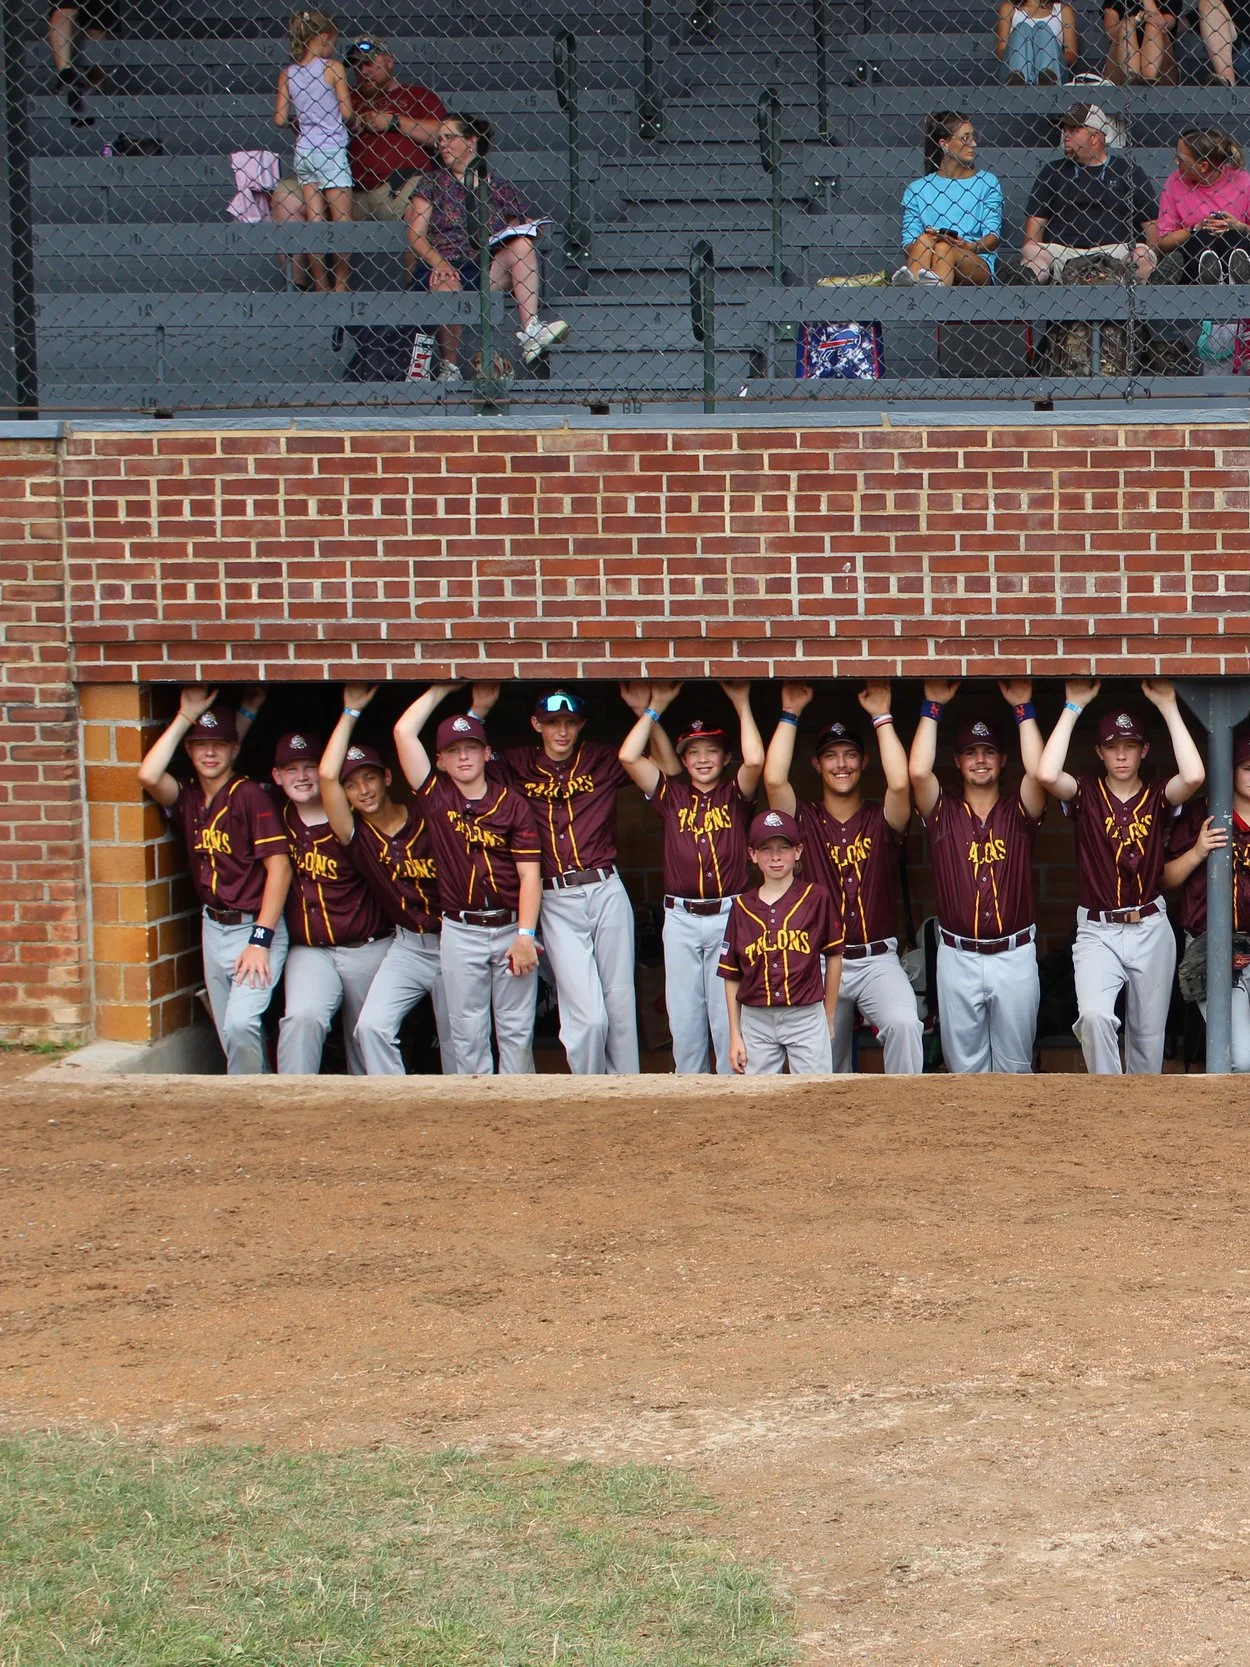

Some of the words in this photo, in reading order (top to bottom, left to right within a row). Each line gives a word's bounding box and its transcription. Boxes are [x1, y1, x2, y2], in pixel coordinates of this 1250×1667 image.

[525, 95, 536, 106] 15
[607, 95, 620, 106] 16
[350, 303, 365, 316] 12
[457, 302, 471, 314] 13
[622, 403, 642, 414] BB
[289, 845, 338, 880] ONS
[745, 930, 810, 966] TALONS
